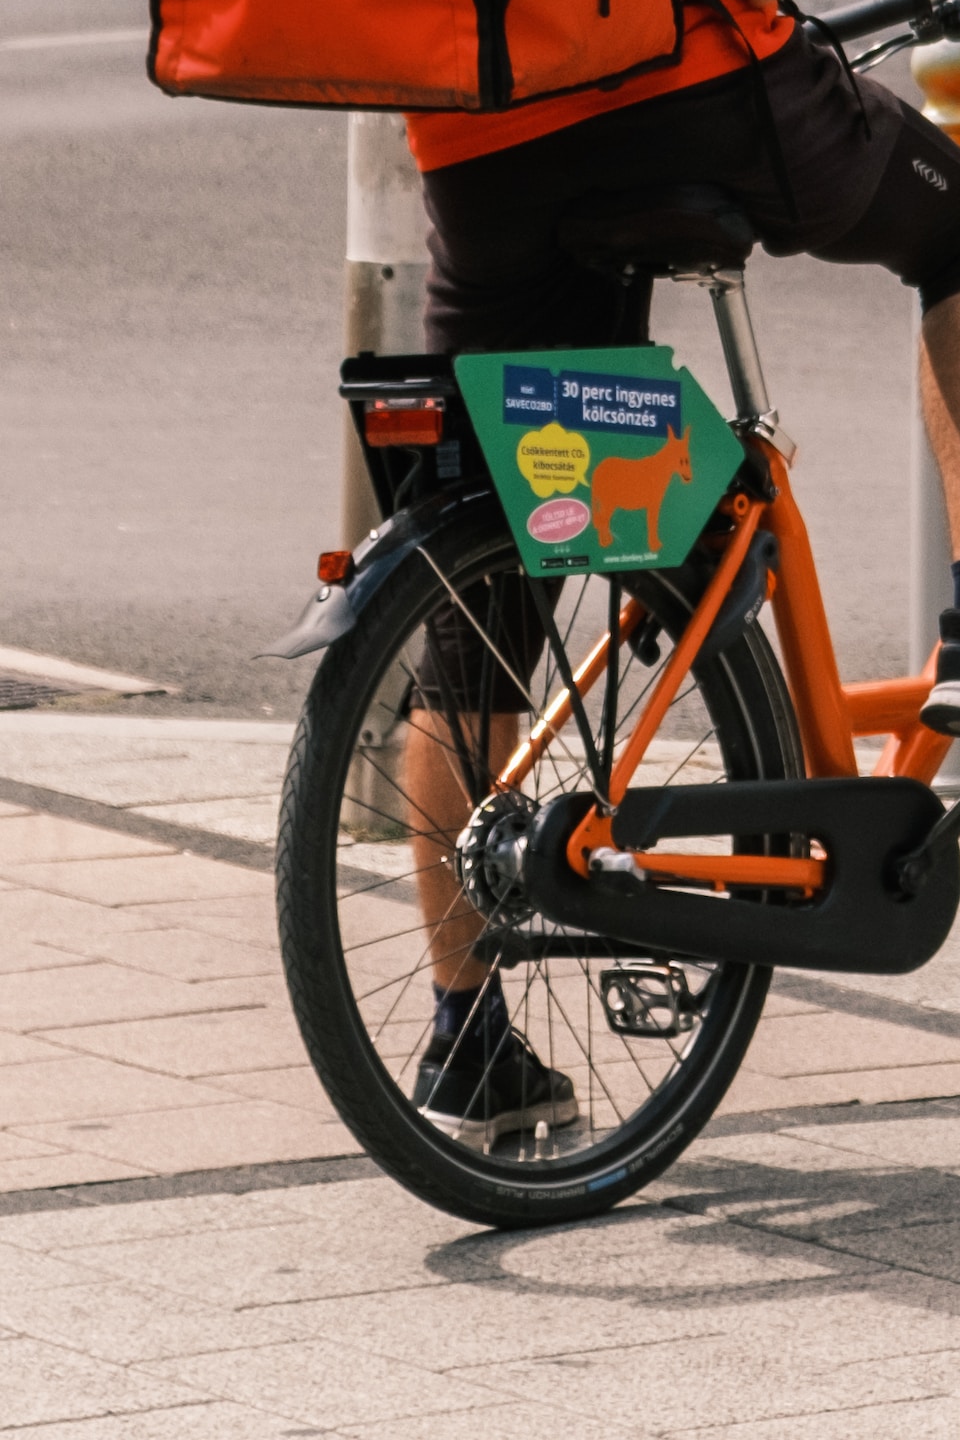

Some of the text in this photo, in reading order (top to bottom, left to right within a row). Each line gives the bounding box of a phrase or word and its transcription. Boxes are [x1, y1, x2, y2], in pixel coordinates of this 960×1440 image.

[562, 381, 676, 408] 30 perc ingyenes
[582, 405, 657, 427] kölcsönzés
